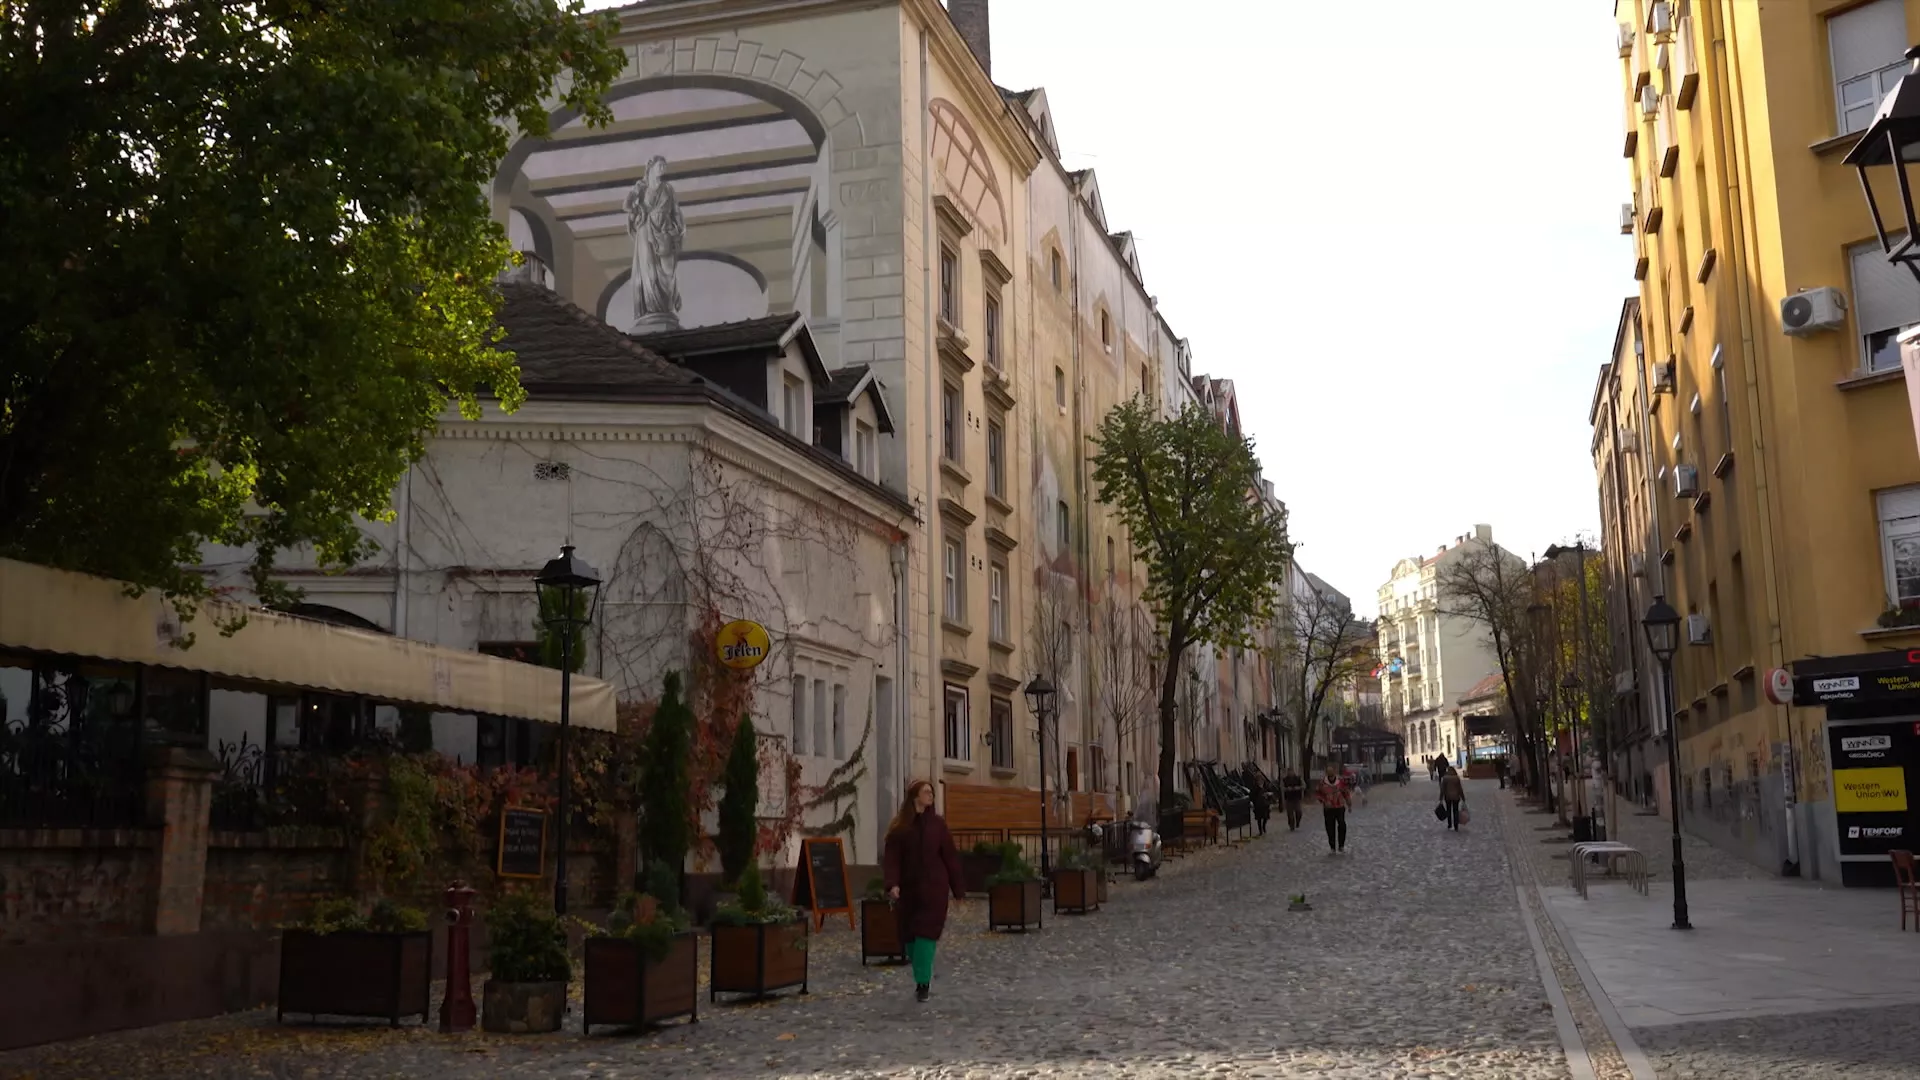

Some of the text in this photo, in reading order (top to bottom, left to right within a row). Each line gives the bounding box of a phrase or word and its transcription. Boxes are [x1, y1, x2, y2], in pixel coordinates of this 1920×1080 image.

[723, 643, 762, 661] Jelen
[1877, 675, 1909, 685] Western
[1843, 782, 1880, 791] Western
[1856, 789, 1881, 798] Union
[1862, 826, 1903, 836] TENFORE
